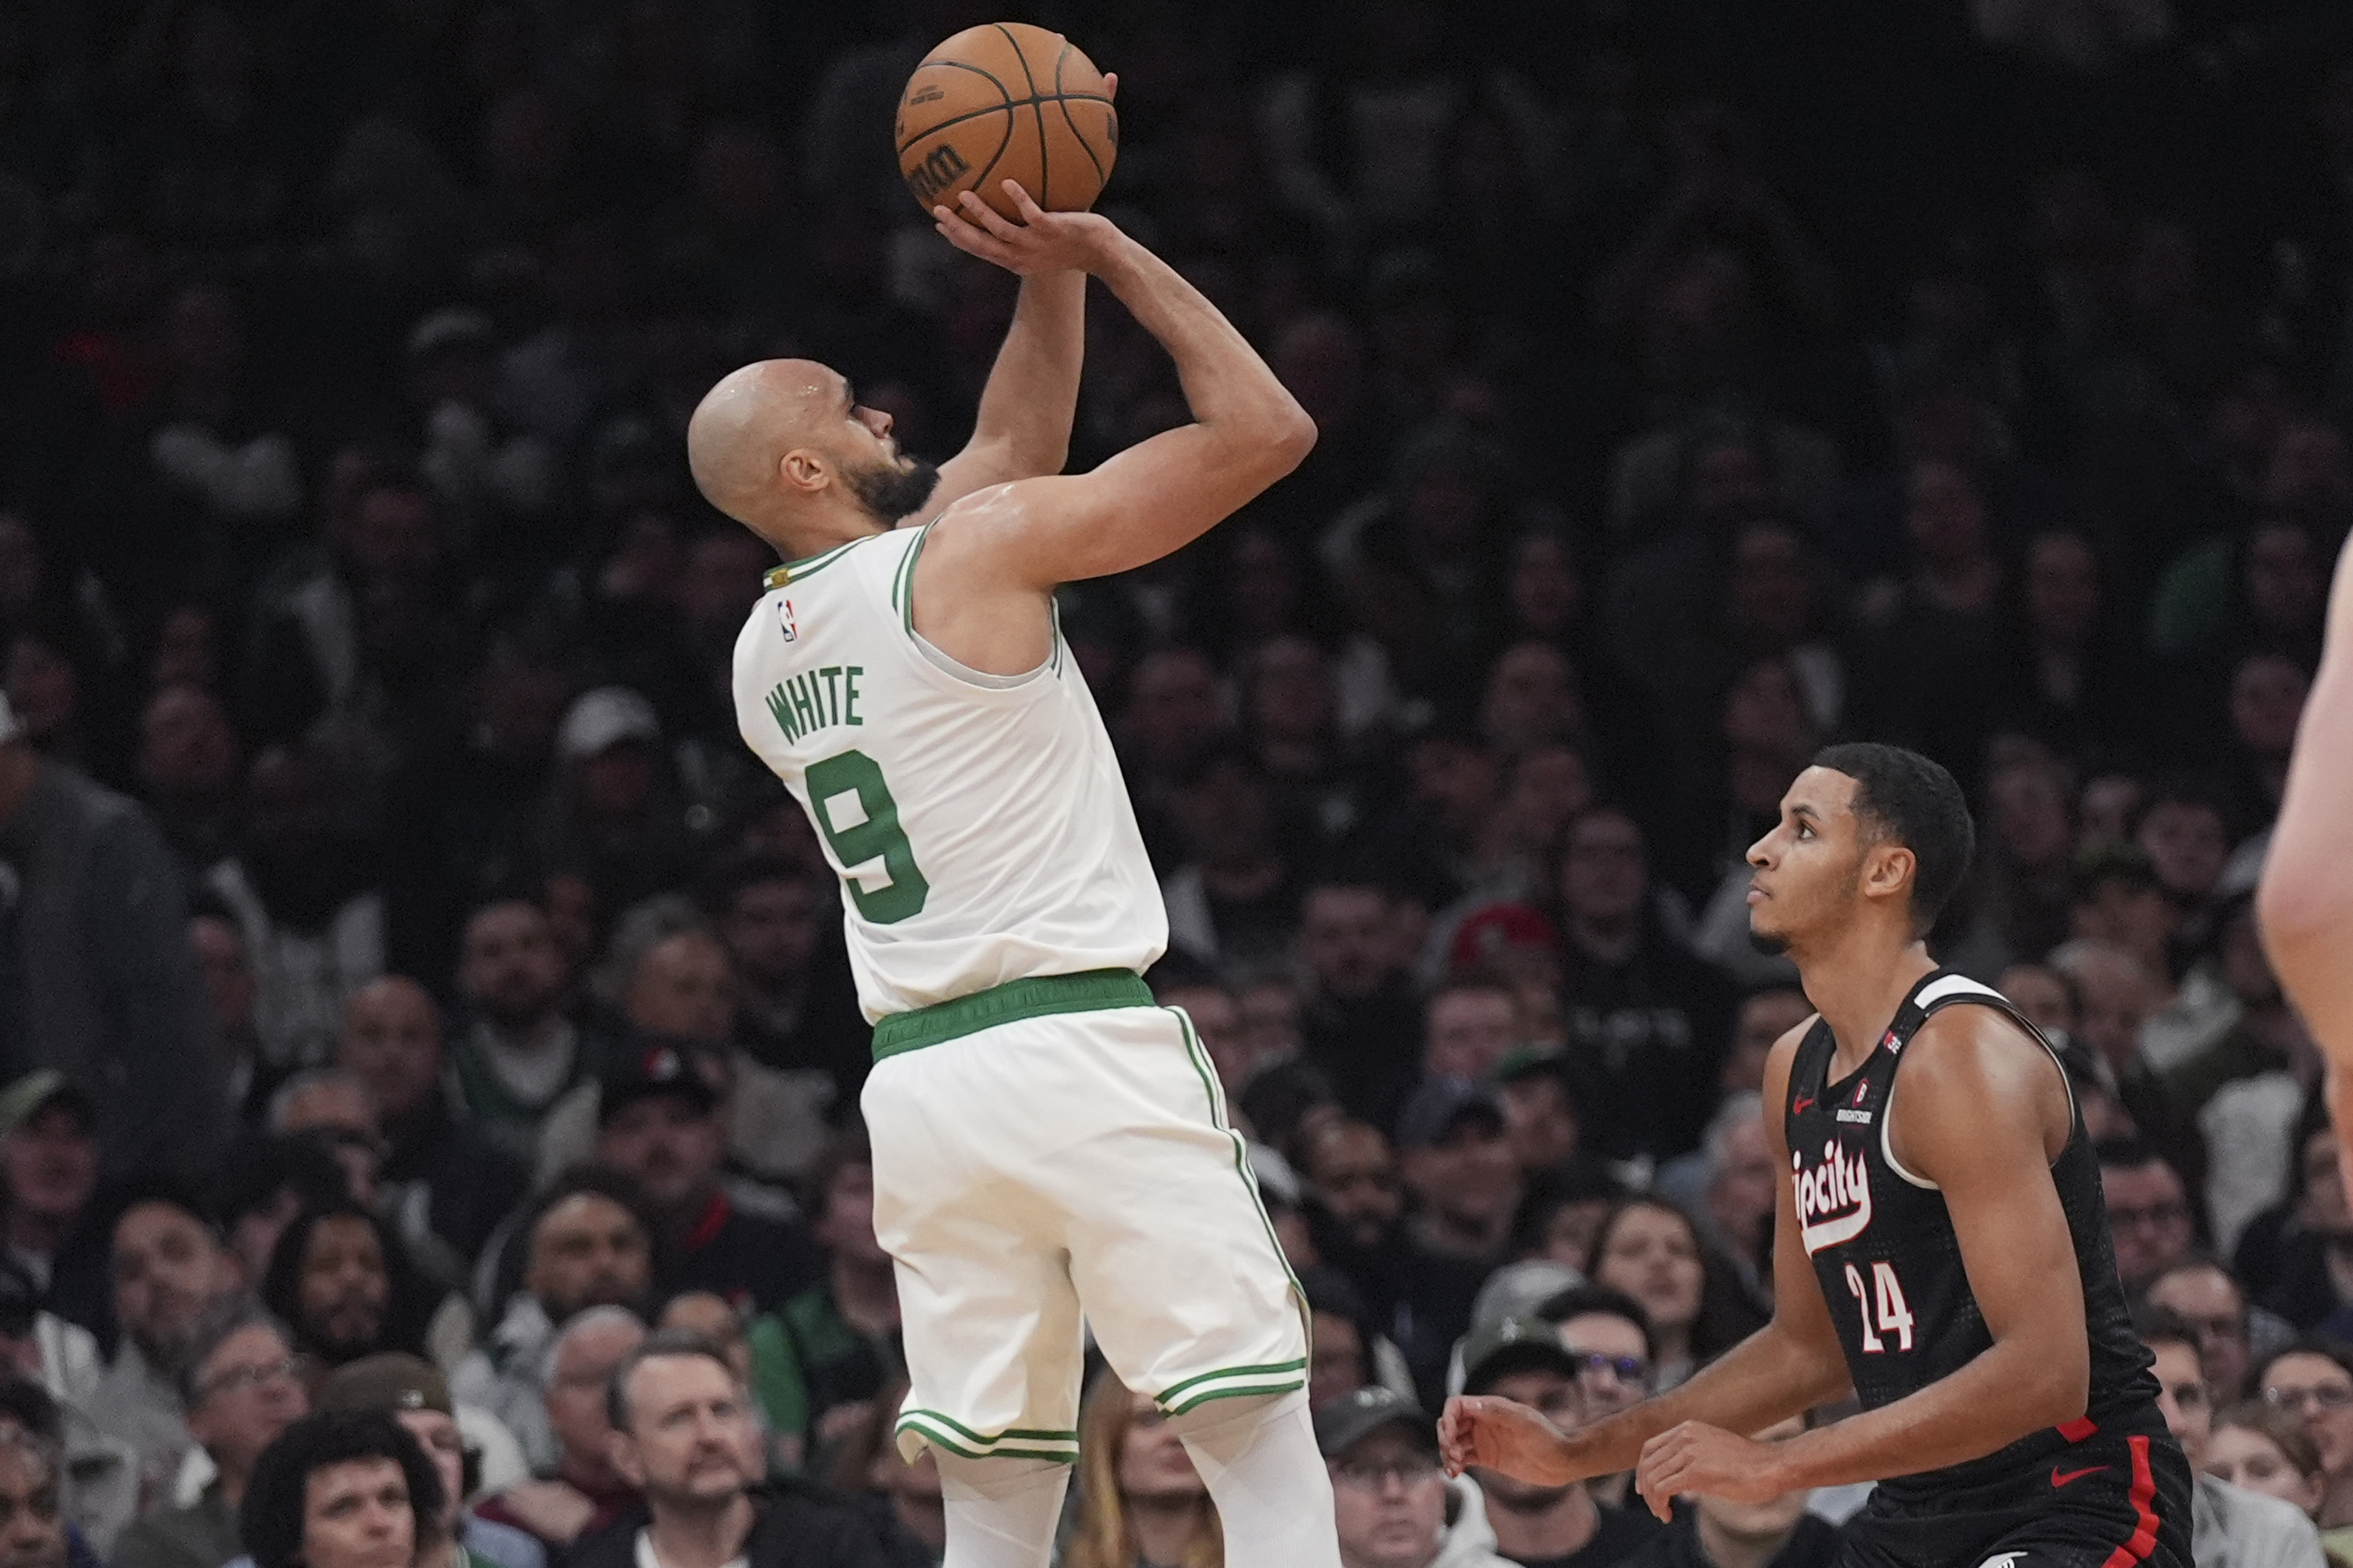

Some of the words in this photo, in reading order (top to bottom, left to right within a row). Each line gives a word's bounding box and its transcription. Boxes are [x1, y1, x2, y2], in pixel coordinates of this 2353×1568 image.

[765, 666, 863, 745] WHITE
[804, 749, 929, 925] 9
[1792, 1135, 1872, 1260] ipcity
[1844, 1262, 1915, 1352] 24
